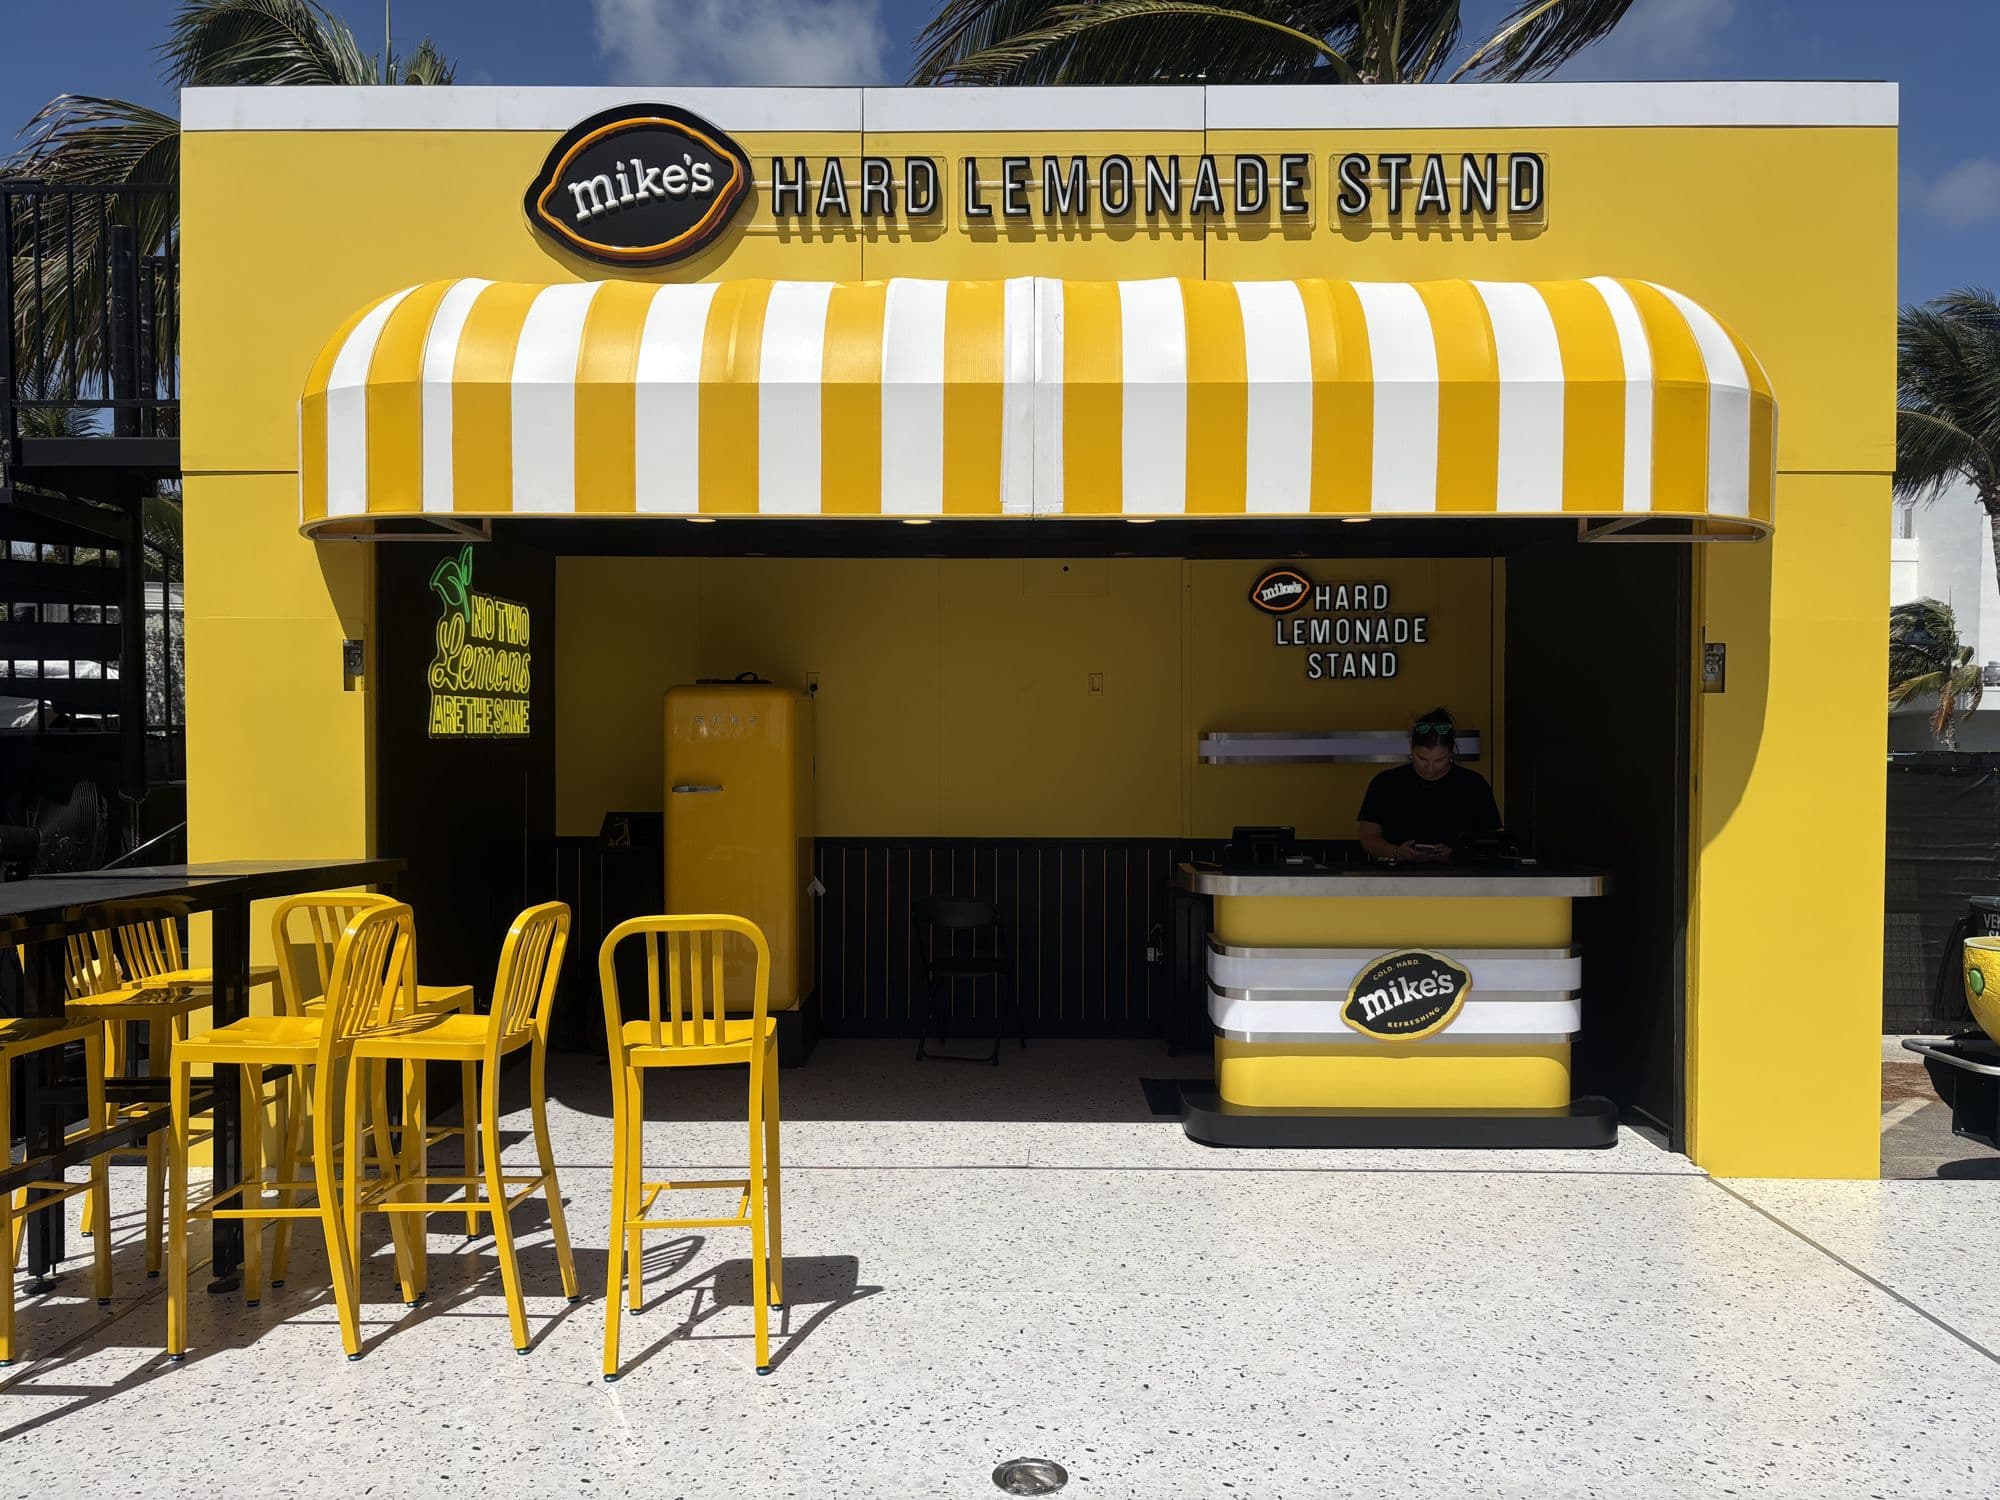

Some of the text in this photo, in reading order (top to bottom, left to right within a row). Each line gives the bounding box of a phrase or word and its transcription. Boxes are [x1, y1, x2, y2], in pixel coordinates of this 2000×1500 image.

[567, 152, 1544, 222] mike's HARD LEMONADE STAND
[1260, 581, 1388, 611] mike's HARD
[471, 595, 530, 647] NO TWO
[1276, 617, 1427, 645] LEMONADE
[432, 612, 532, 694] Lemons
[1307, 652, 1397, 679] STAND
[432, 694, 530, 735] ARE THE SAME
[1358, 970, 1455, 1022] mike's
